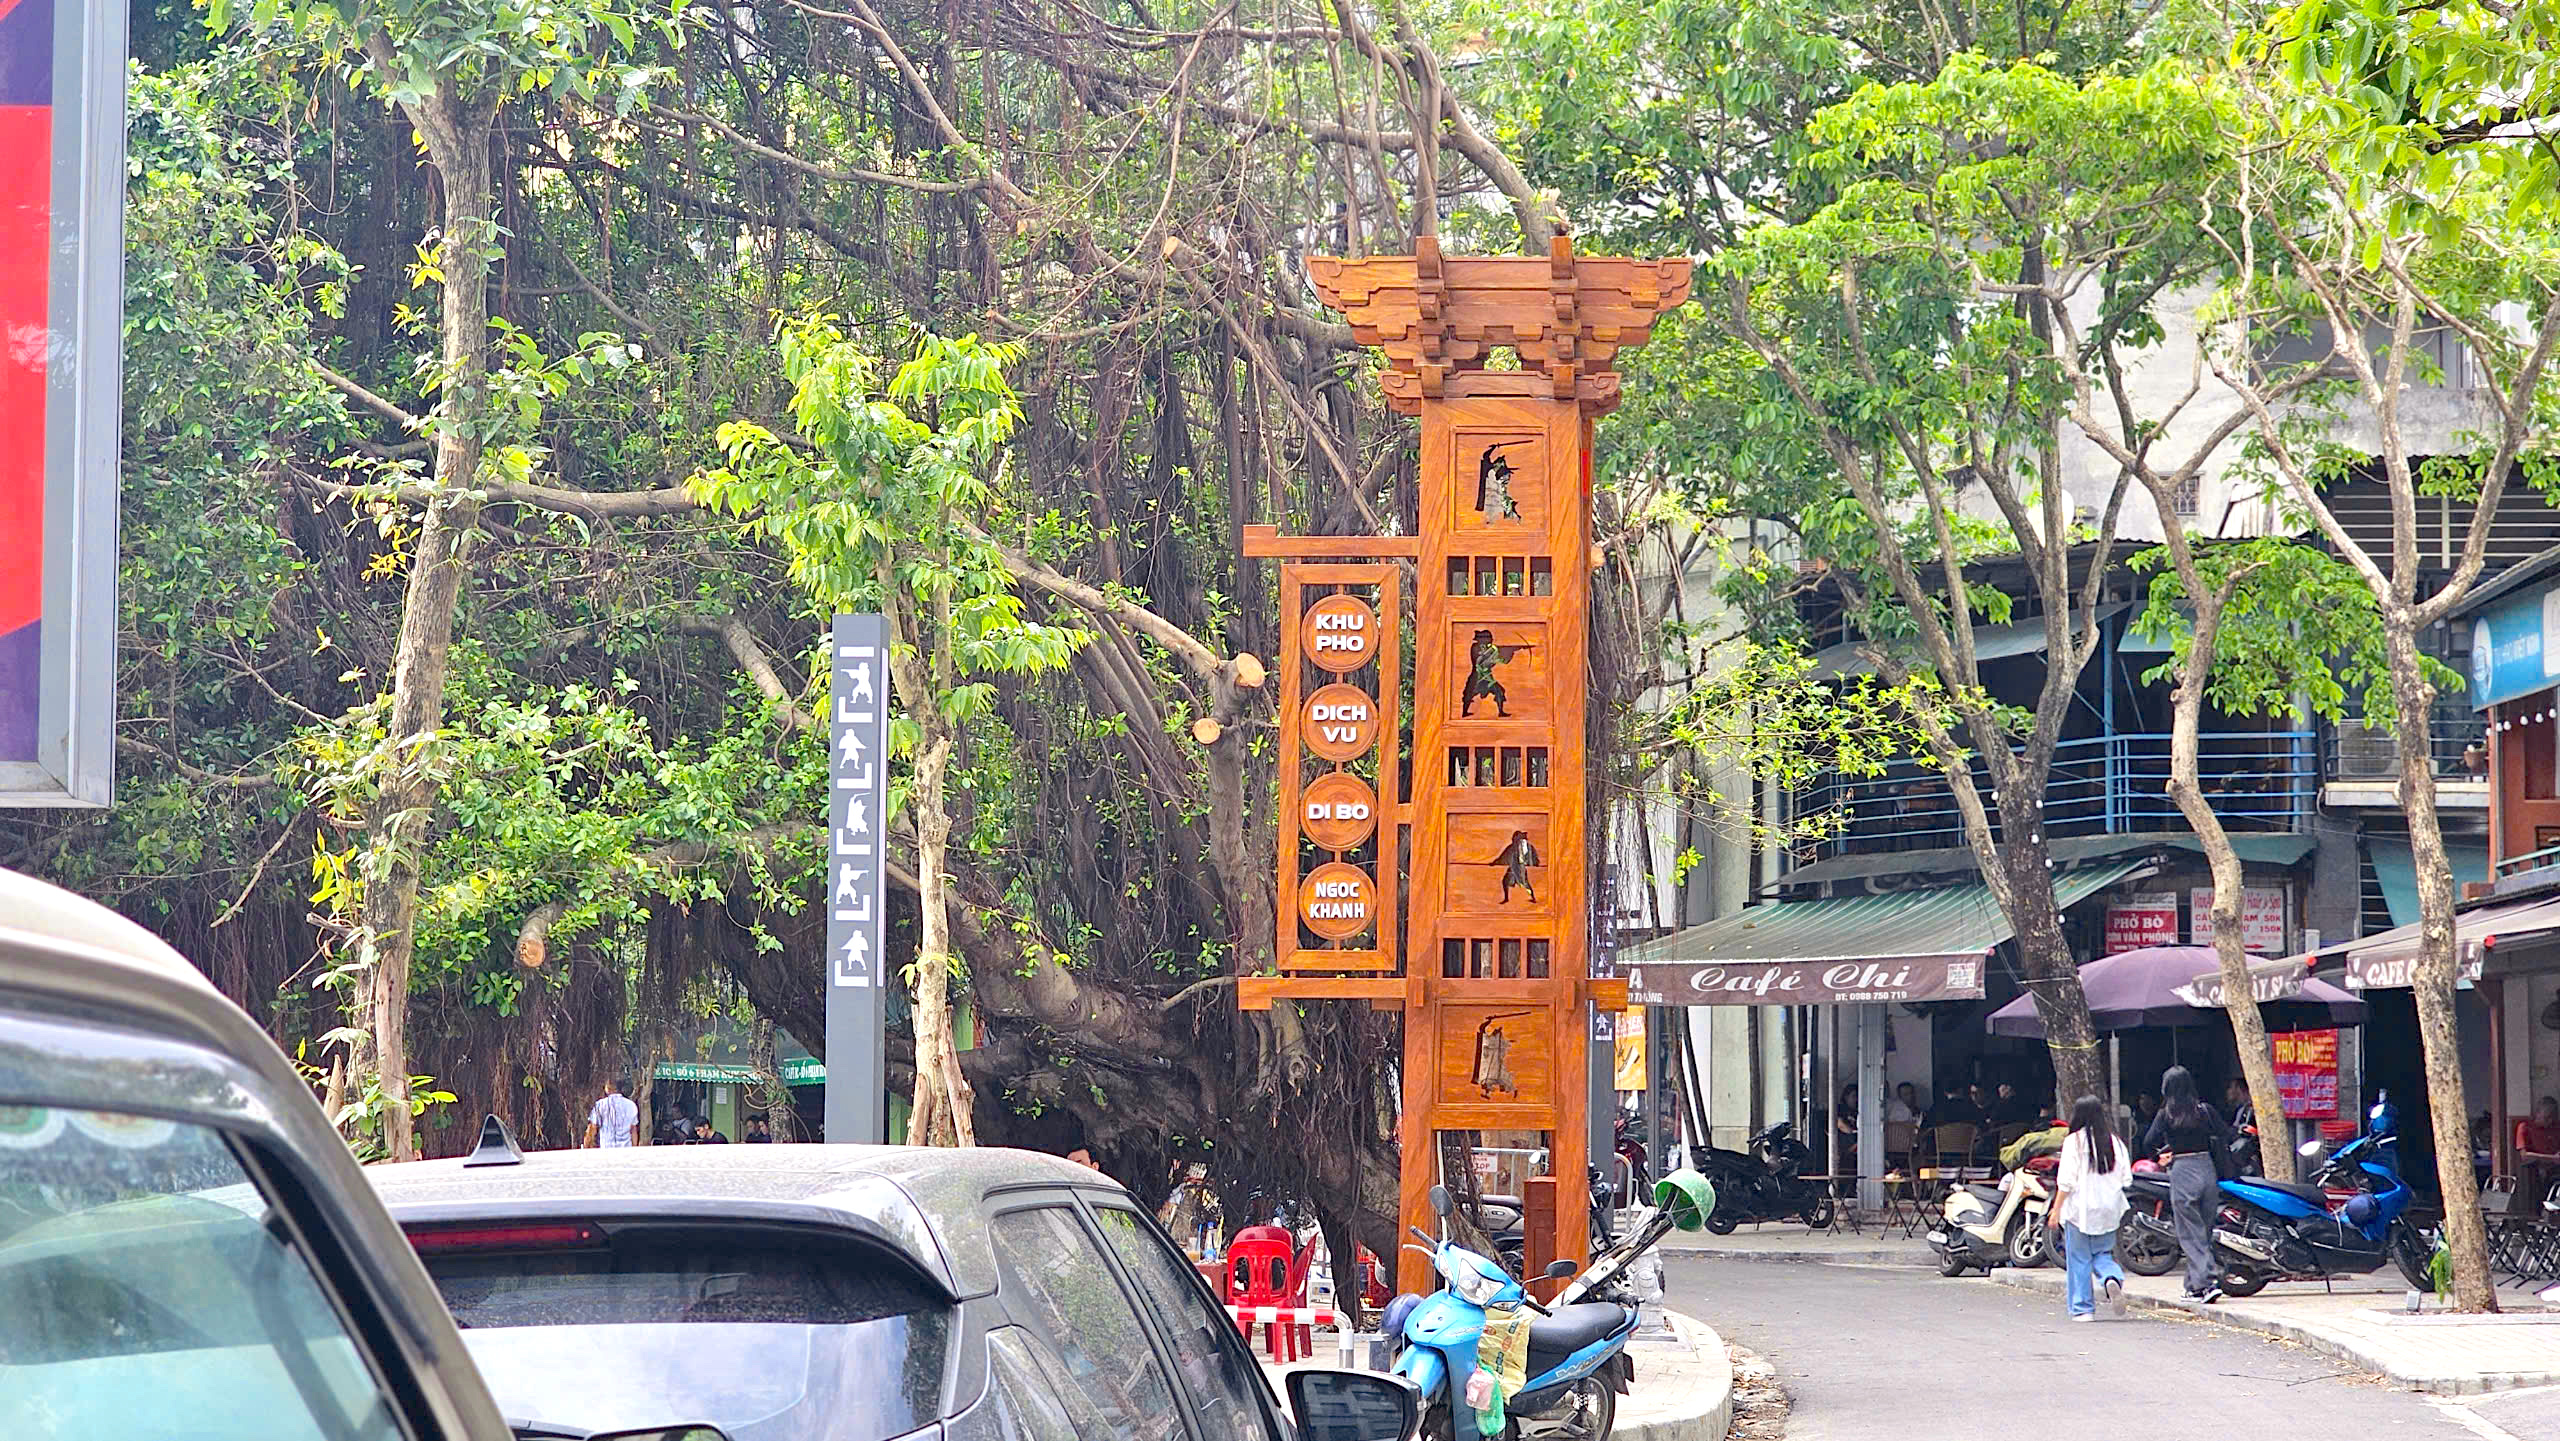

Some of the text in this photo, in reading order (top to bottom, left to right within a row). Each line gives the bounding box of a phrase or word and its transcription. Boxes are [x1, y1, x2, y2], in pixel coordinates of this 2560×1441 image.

[1315, 614, 1364, 631] KHU
[1315, 635, 1365, 651] PHO
[1312, 705, 1367, 721] DICH
[1321, 726, 1357, 742] VU
[1308, 803, 1369, 820] DI BO
[1315, 882, 1360, 898] NGOC
[1309, 903, 1365, 919] KHANH
[2113, 913, 2164, 929] PHỞ BÒ
[1690, 963, 1912, 996] Café Chi
[2275, 1033, 2296, 1064] PHỞ
